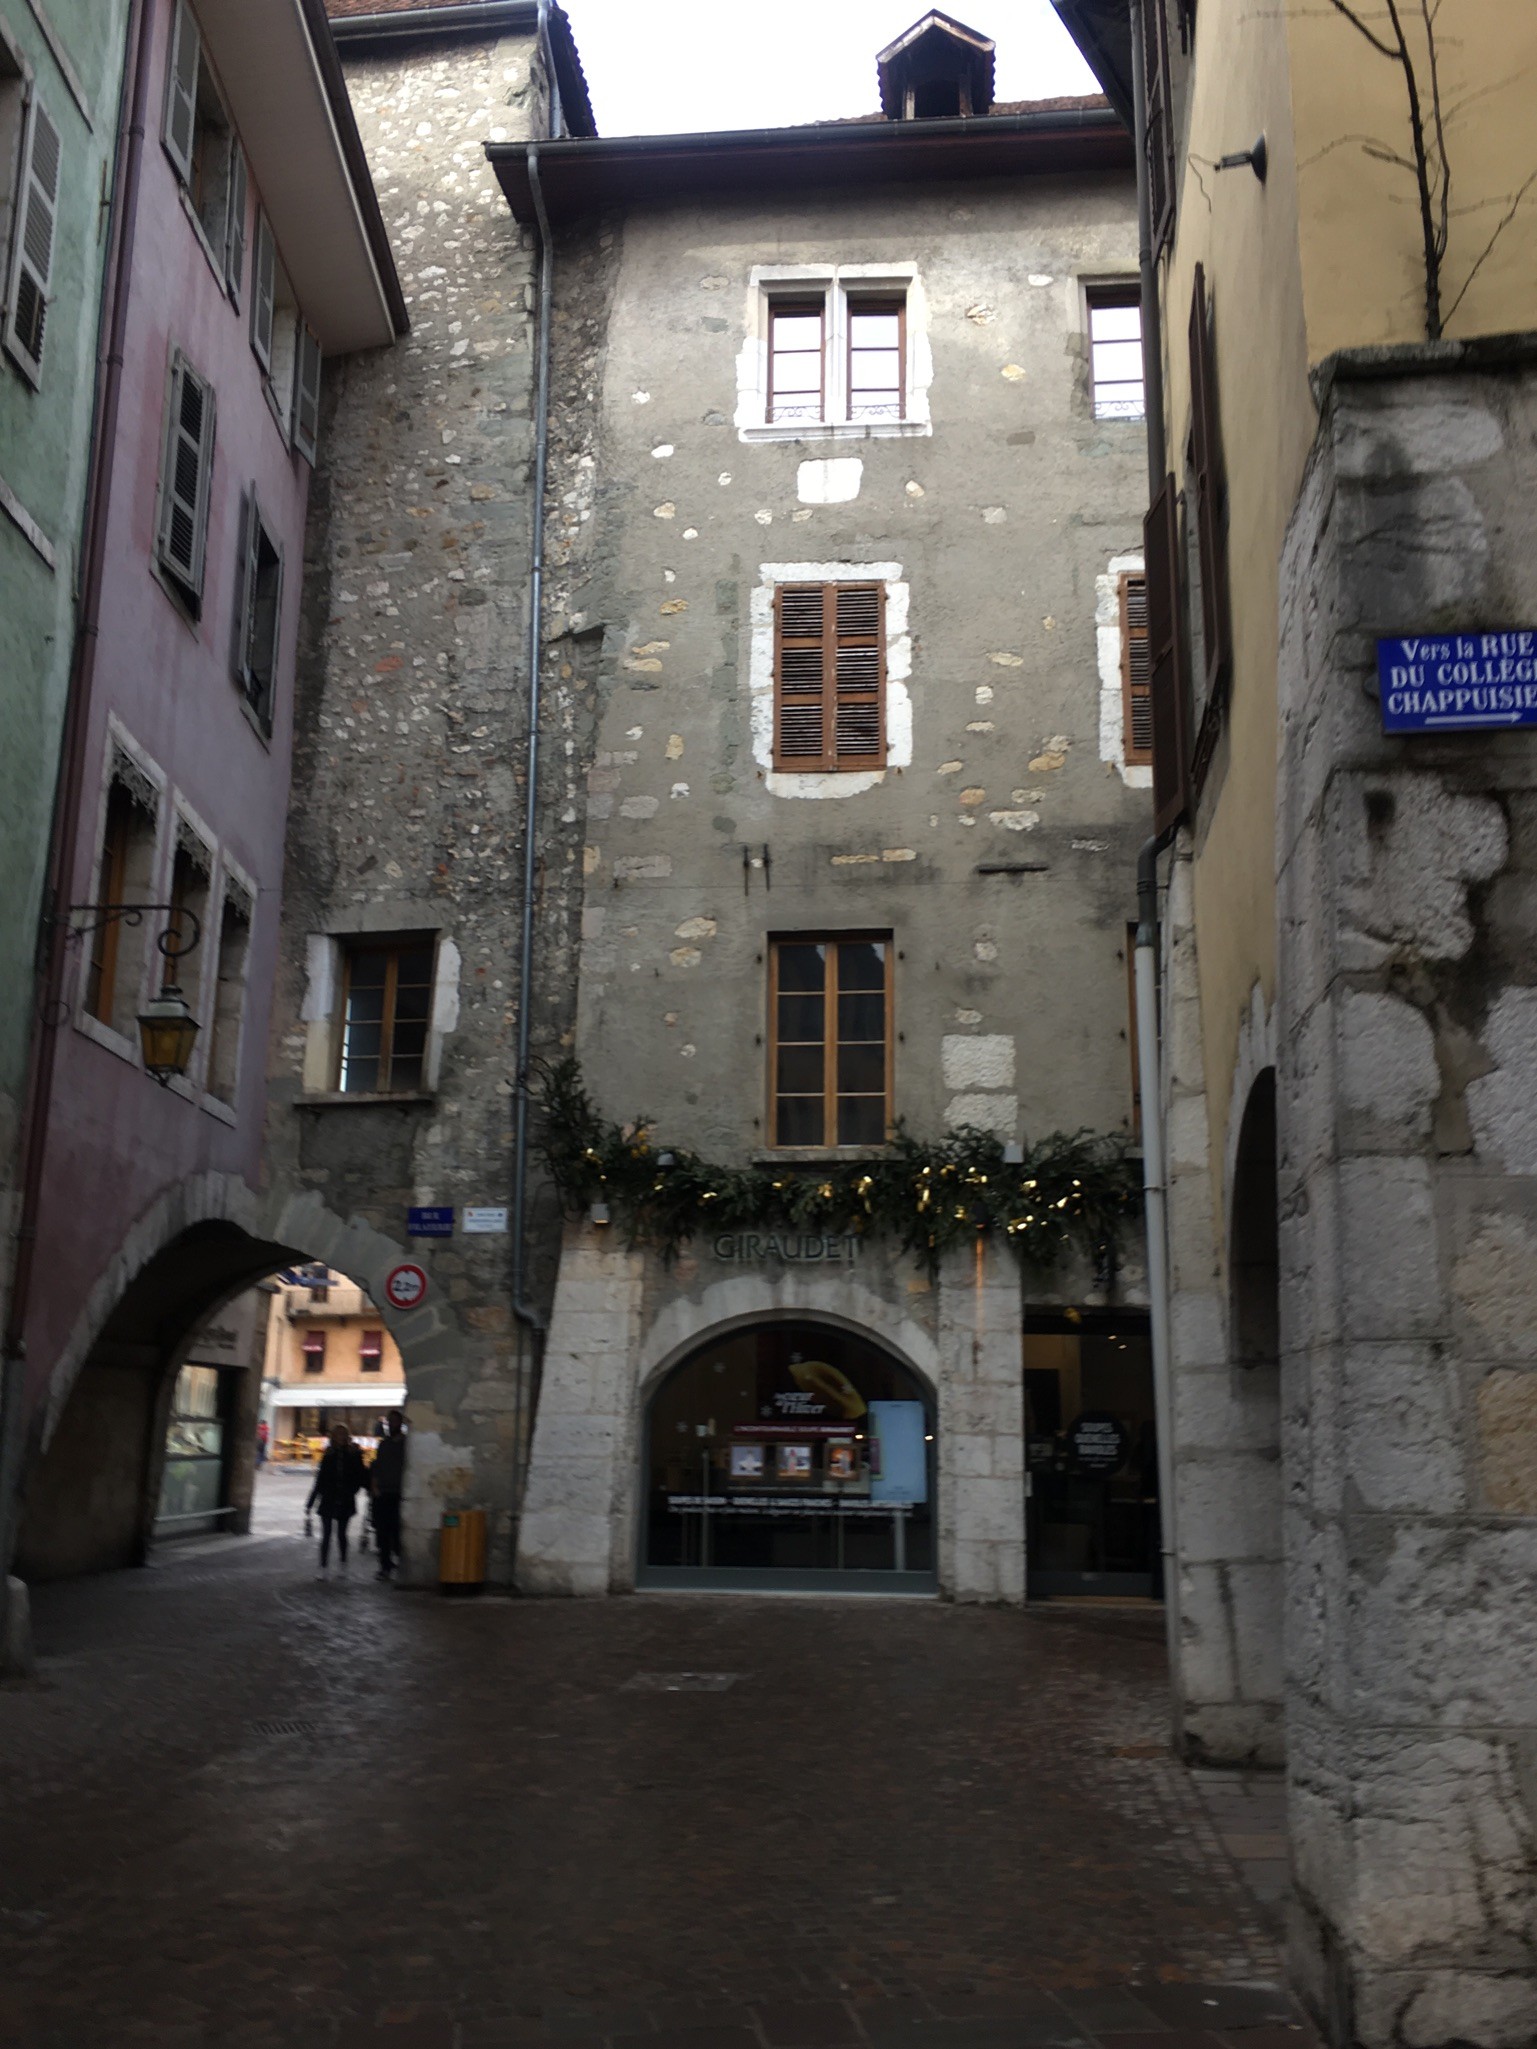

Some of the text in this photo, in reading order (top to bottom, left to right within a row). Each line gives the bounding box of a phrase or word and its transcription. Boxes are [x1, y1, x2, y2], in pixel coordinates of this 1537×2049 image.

[1401, 632, 1534, 662] Vers la RUE
[1390, 664, 1425, 689] DU
[714, 1233, 863, 1260] GIRAUDET
